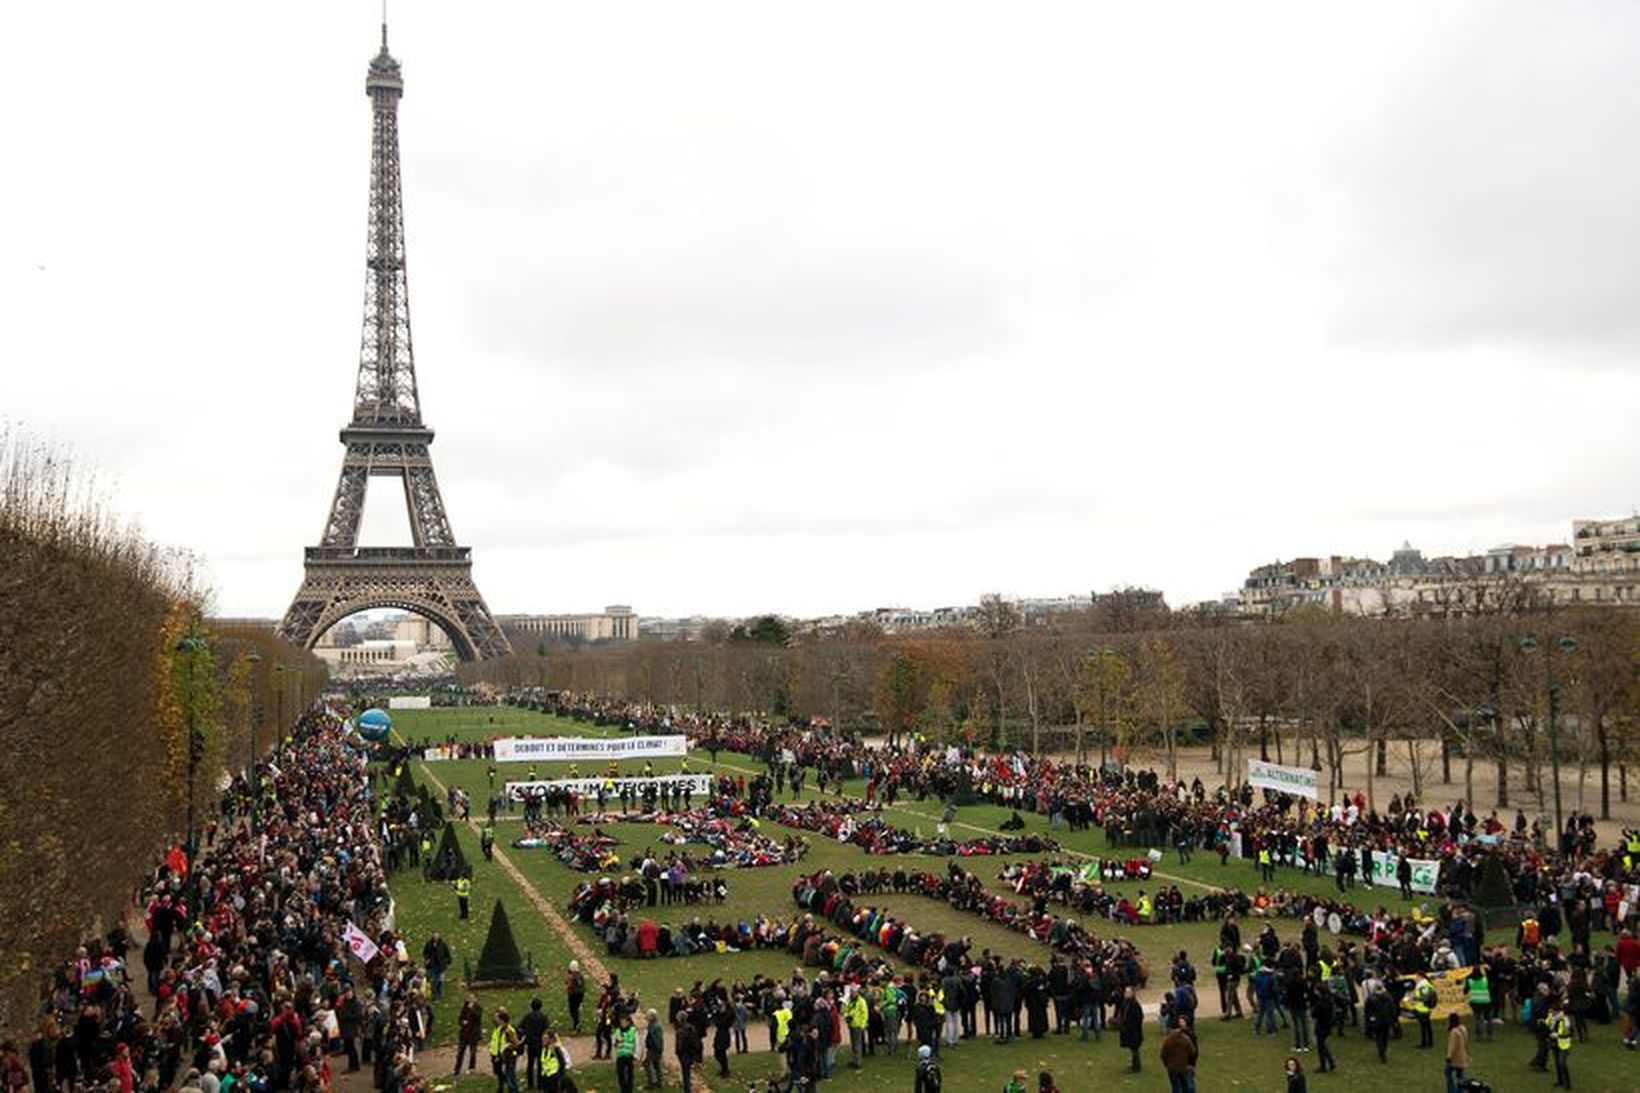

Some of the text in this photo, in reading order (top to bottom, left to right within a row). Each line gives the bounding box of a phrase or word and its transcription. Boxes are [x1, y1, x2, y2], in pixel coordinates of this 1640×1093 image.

[546, 743, 555, 752] ET
[607, 742, 625, 751] POUR
[628, 741, 635, 750] LE
[637, 740, 662, 749] CLIMAT
[638, 779, 697, 793] CRMES
